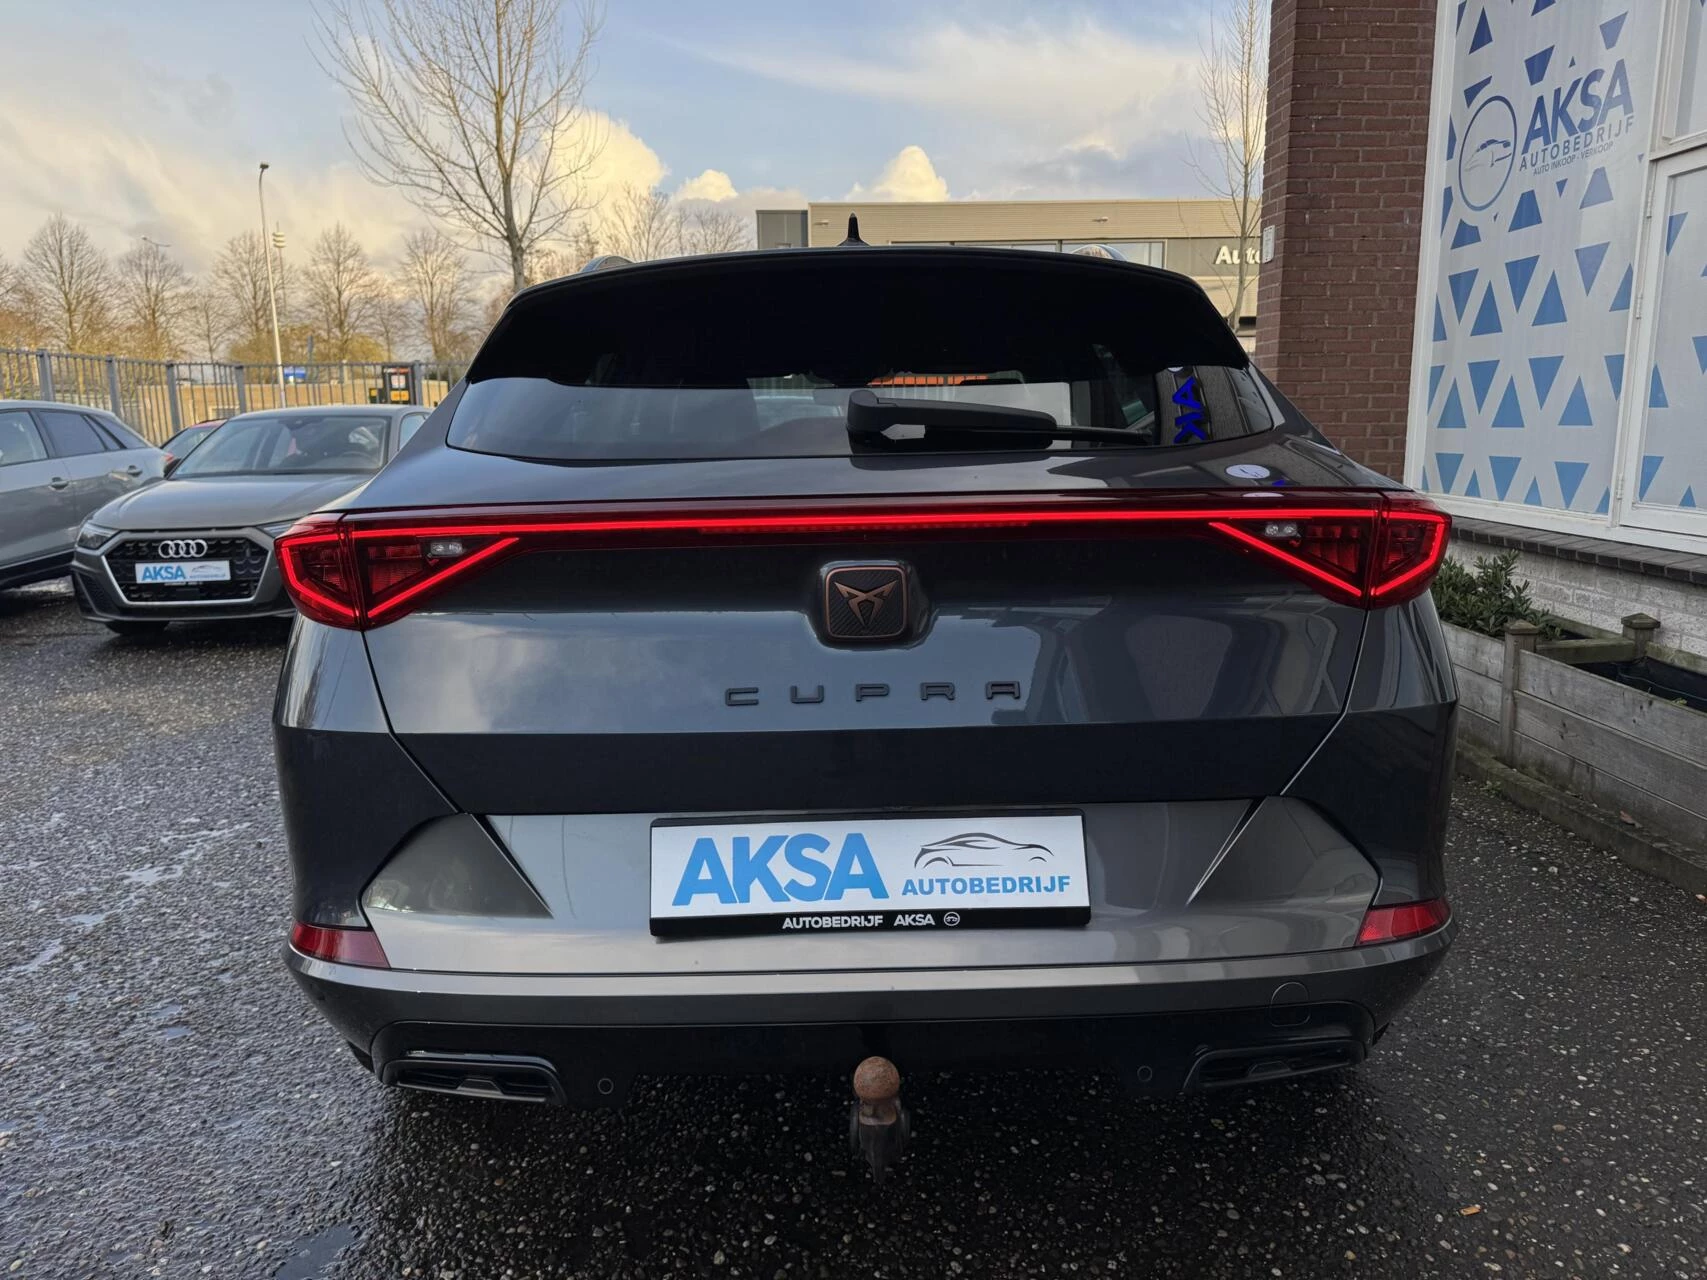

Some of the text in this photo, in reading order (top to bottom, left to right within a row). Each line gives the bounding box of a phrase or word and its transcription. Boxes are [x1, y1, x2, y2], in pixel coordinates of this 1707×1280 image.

[1521, 58, 1633, 154] AKSA
[1519, 115, 1634, 171] AUTOBEDRIJF
[1533, 165, 1550, 176] AUTO
[1550, 155, 1576, 170] INKOOP
[142, 565, 186, 581] AKSA
[725, 680, 1022, 706] CUPRA
[671, 833, 890, 907] AKSA
[901, 876, 1071, 896] AUTOBEDRIJF
[782, 914, 936, 930] AUTOBEDRIJF AKSA
